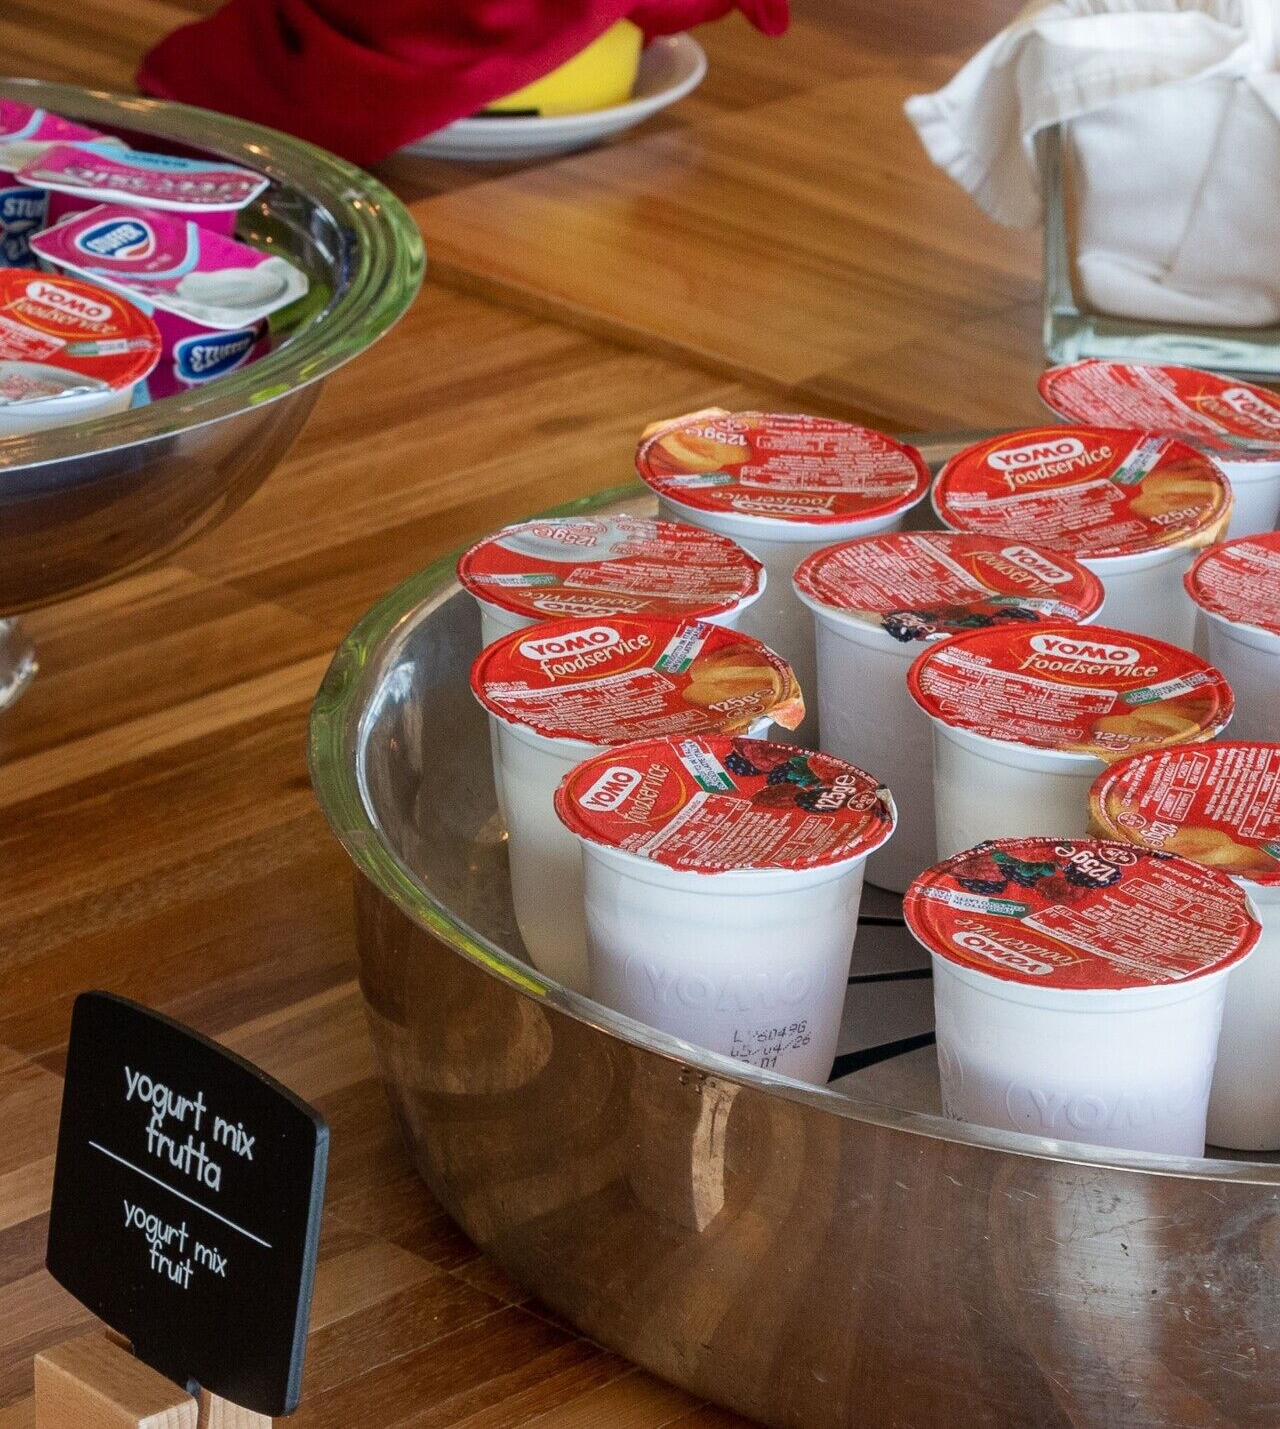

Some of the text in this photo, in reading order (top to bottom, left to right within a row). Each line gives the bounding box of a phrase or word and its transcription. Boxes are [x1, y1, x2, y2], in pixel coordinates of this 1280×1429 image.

[37, 286, 104, 319] YOMO
[996, 441, 1076, 467] YOMO
[1002, 443, 1113, 491] foodservice
[1010, 548, 1065, 579] YOMO
[527, 631, 610, 656] YOMO
[540, 632, 651, 683] foodservice
[1041, 637, 1130, 662] YOMO
[1017, 653, 1159, 678] foodservice
[585, 771, 635, 807] YOMO
[614, 763, 670, 827] foodservice
[955, 918, 1094, 967] foodservice
[962, 936, 1042, 974] YOMO
[124, 1066, 256, 1161] yogurt mix
[145, 1112, 222, 1192] frutta
[123, 1199, 228, 1278] yogurt mix
[149, 1238, 194, 1290] fruit
